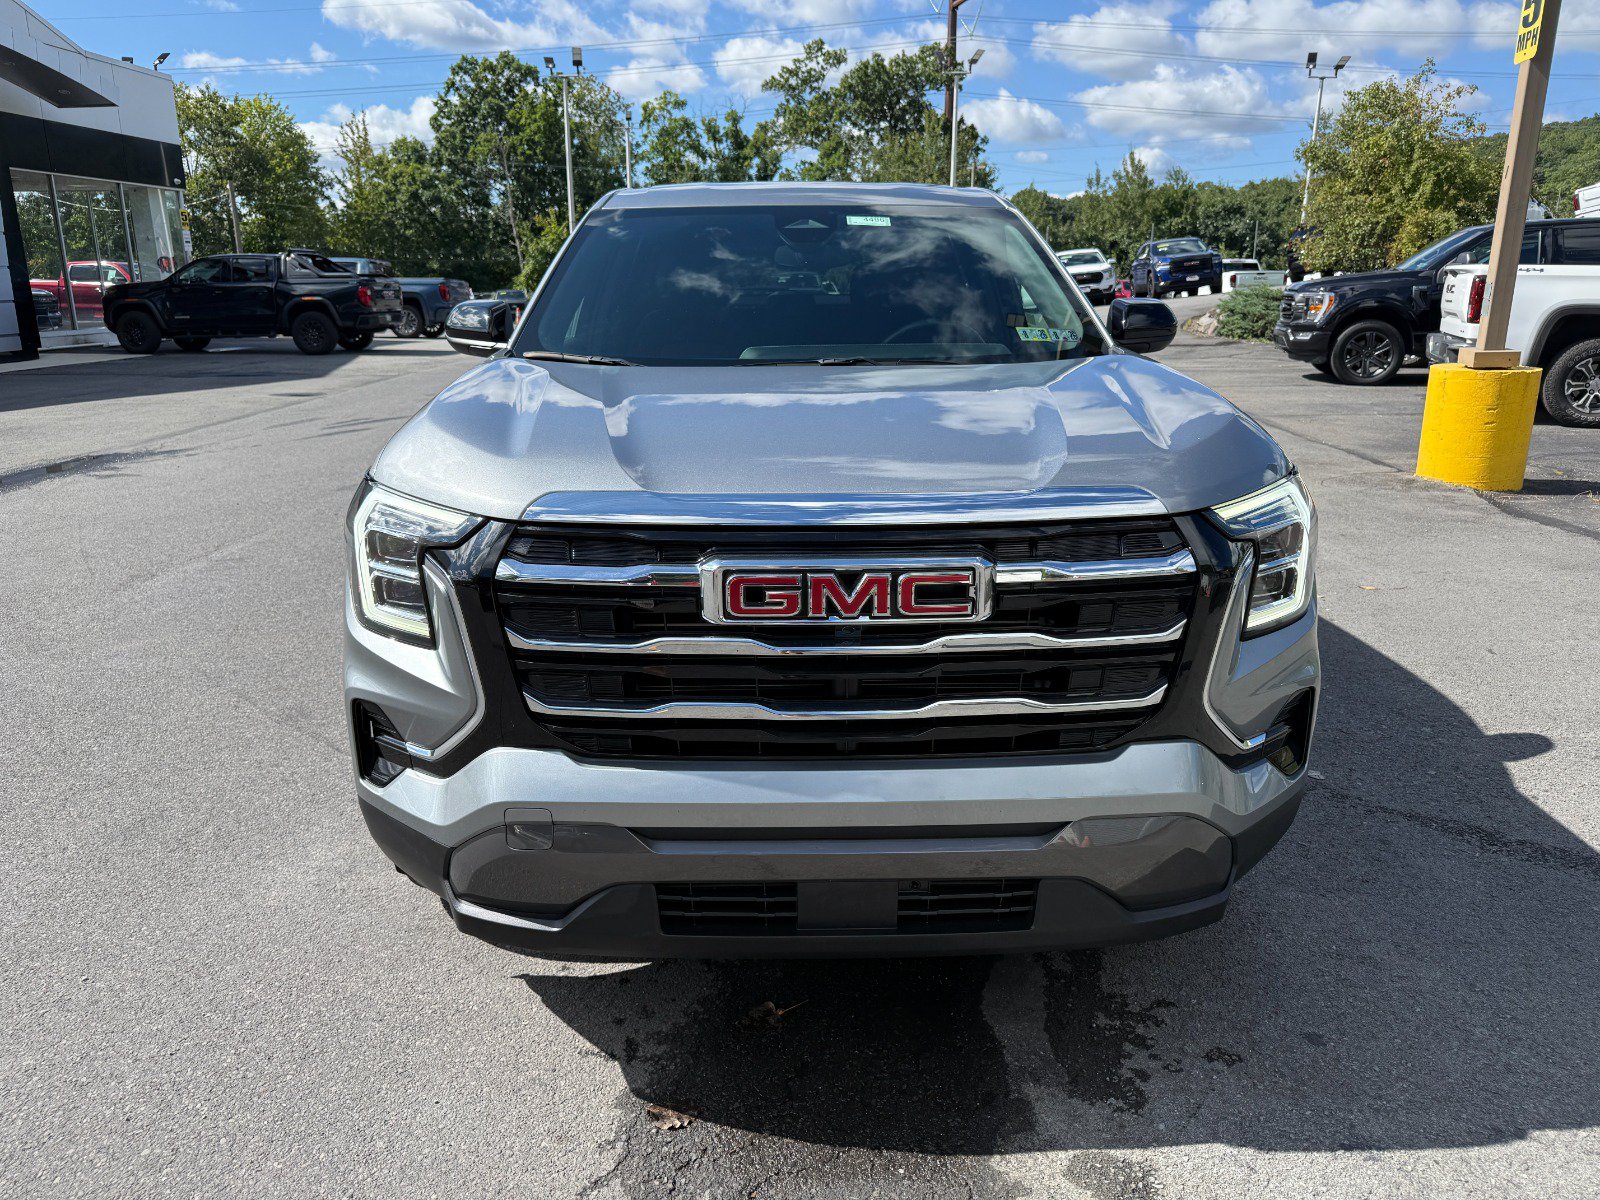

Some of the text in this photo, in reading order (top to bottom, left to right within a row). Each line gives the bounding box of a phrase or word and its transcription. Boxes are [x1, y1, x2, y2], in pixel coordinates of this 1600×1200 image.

[1522, 0, 1543, 28] 5
[1516, 26, 1540, 53] MPH
[181, 212, 188, 221] 5
[726, 572, 975, 618] GMC
